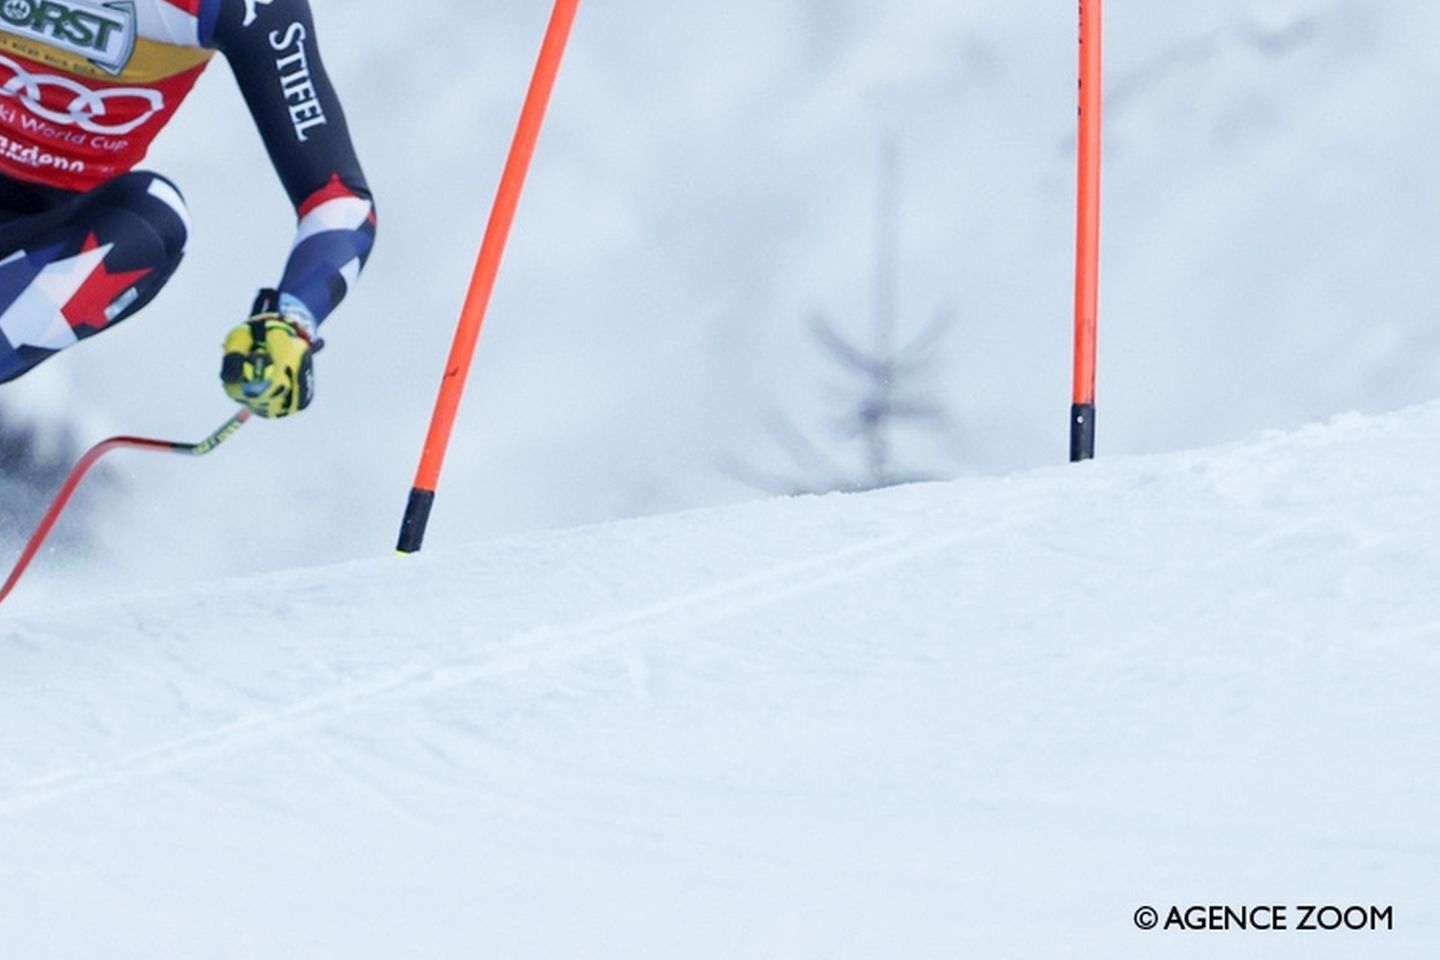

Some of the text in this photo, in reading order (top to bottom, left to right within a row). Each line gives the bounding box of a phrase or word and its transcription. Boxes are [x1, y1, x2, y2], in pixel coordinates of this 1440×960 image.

[269, 21, 327, 141] STIFEL
[19, 113, 86, 145] World
[89, 135, 128, 153] Cup
